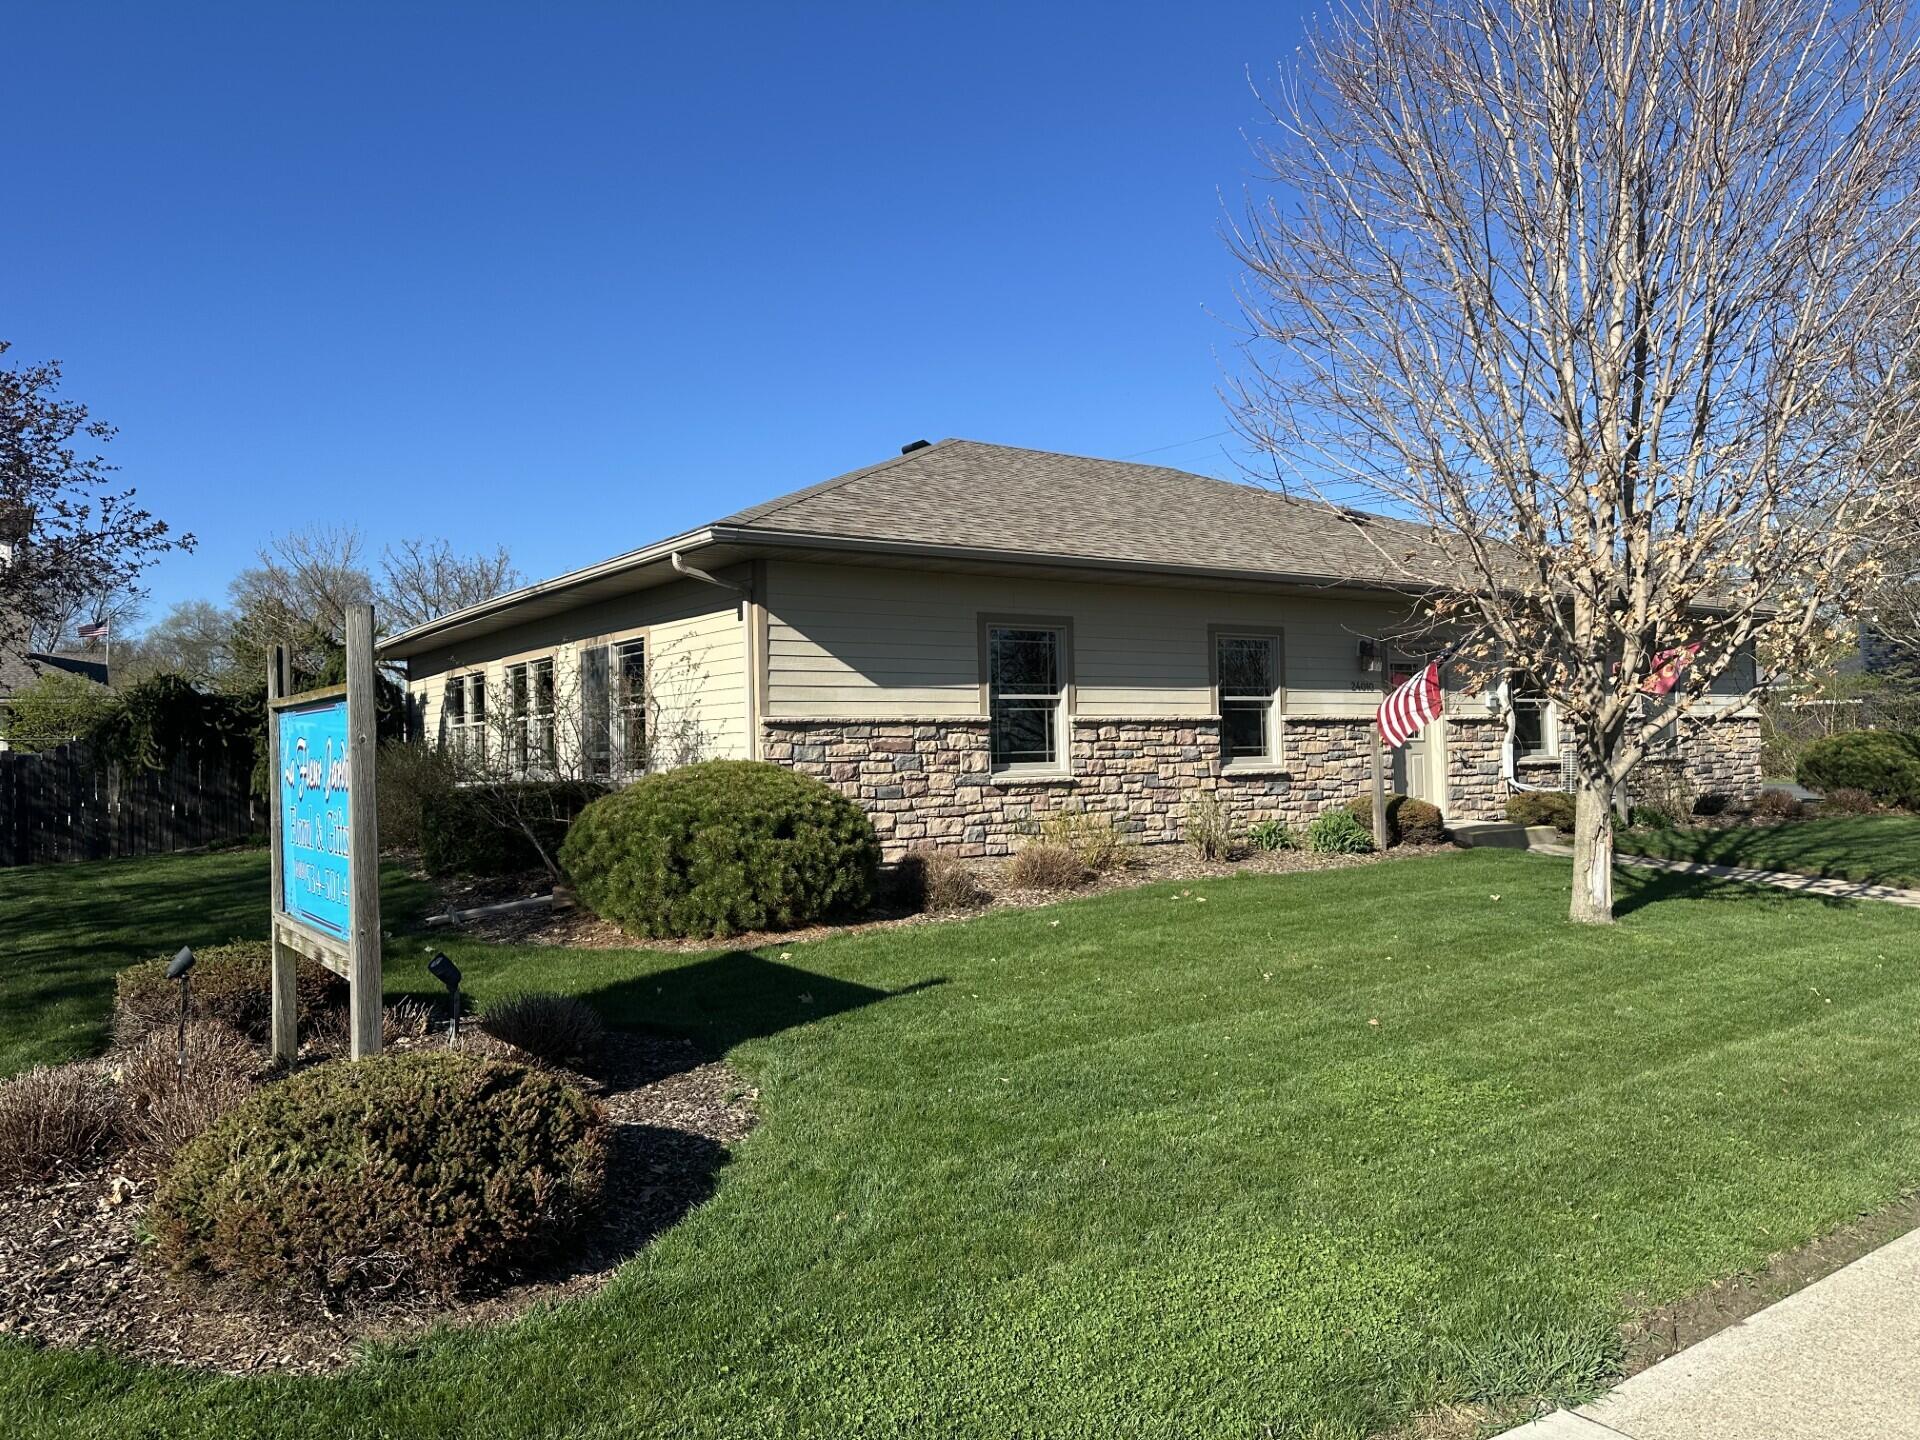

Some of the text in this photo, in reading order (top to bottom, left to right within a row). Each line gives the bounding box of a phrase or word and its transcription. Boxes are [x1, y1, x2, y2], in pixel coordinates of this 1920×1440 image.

[296, 736, 322, 801] Fleur
[323, 736, 350, 803] Jardi
[290, 804, 350, 858] Floral & Gifts
